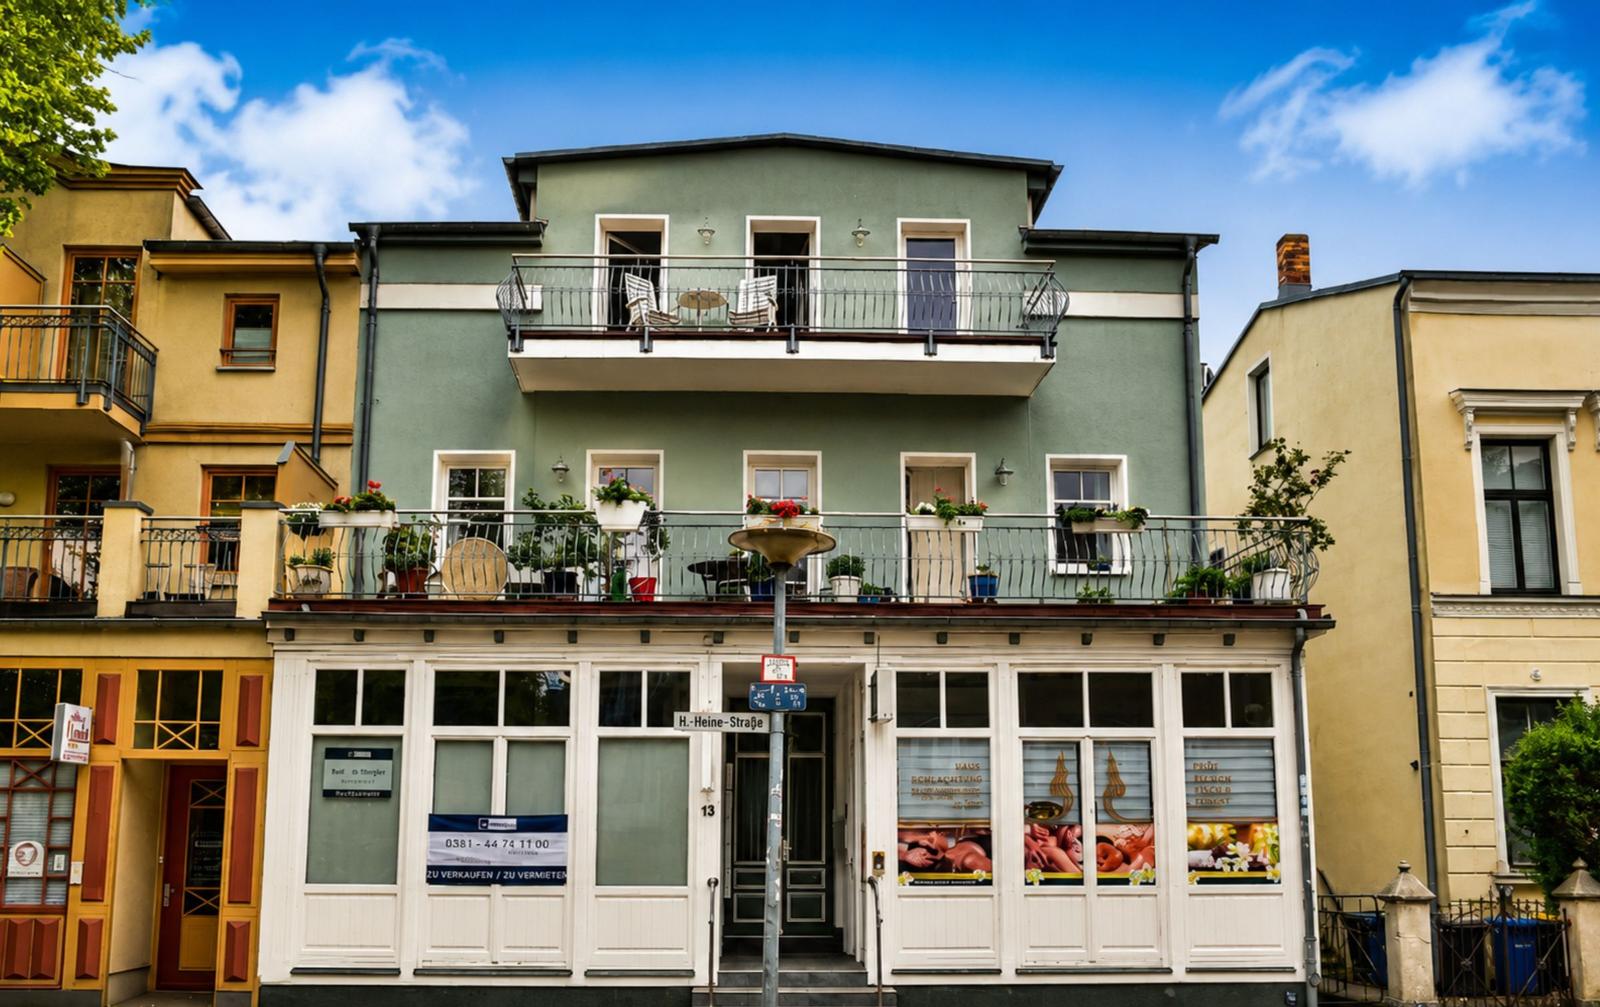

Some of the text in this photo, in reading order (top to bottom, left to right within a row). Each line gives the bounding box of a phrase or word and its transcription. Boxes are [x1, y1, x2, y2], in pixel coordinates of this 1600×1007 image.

[679, 715, 763, 730] H.-Heine-Straße
[701, 804, 715, 817] 13
[445, 839, 472, 849] 0381
[484, 839, 498, 849] 44
[502, 839, 515, 849] 74
[427, 870, 439, 879] ZU
[441, 870, 494, 880] VERKAUFEN
[503, 871, 516, 880] ZU
[518, 871, 567, 880] VERMIETEN
